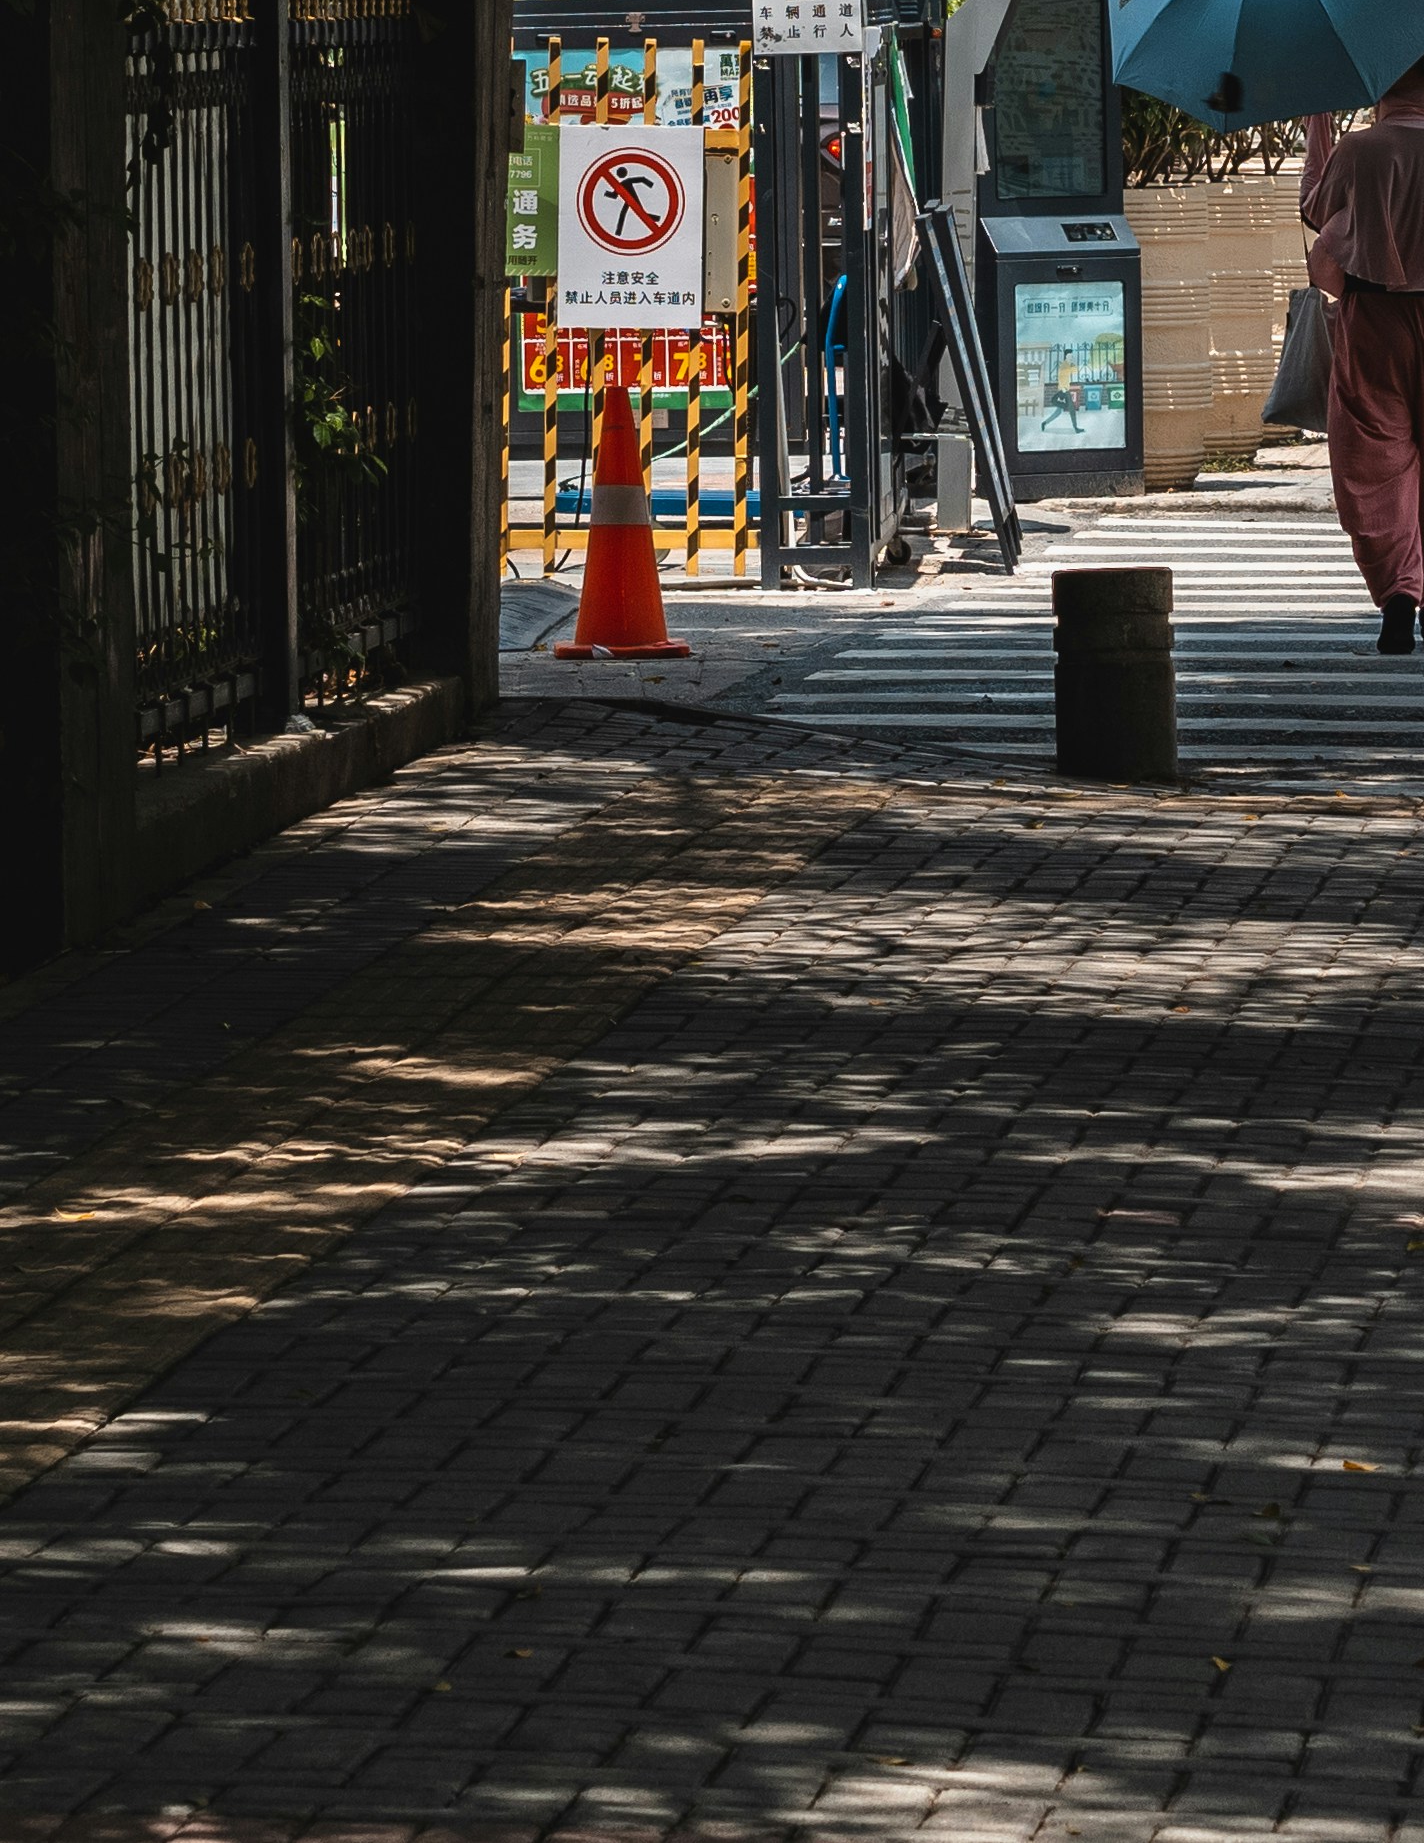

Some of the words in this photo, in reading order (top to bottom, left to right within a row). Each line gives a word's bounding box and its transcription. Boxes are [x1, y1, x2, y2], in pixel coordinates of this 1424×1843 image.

[759, 3, 853, 20] 车辆通道
[758, 23, 854, 41] 禁止行人
[602, 271, 659, 285] 注意安全
[564, 291, 697, 306] 禁止人员进入车道内
